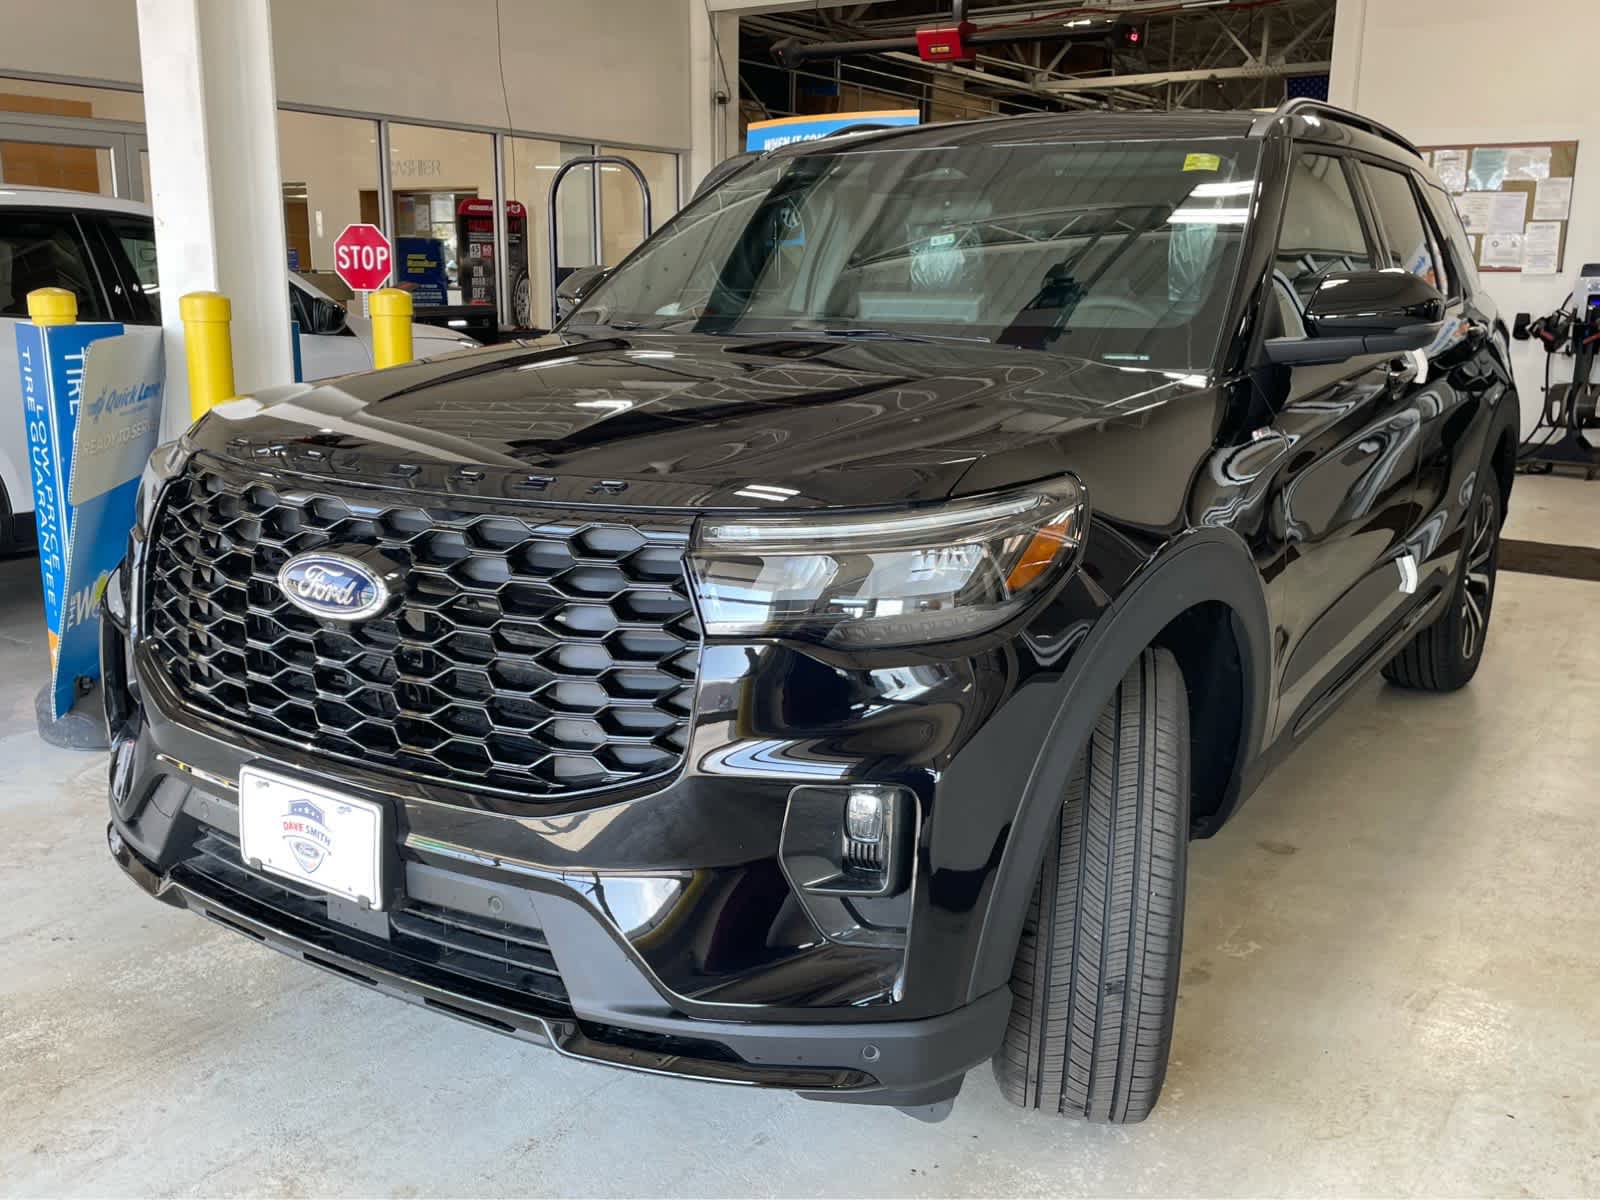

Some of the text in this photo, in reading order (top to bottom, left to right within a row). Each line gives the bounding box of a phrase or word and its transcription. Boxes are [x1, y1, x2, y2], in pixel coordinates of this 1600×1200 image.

[338, 245, 389, 271] STOP
[22, 346, 57, 605] TIRE GUARANTEE
[36, 404, 60, 570] LOW PRICE
[298, 565, 357, 605] Ford
[283, 821, 331, 846] DAVE SMITH
